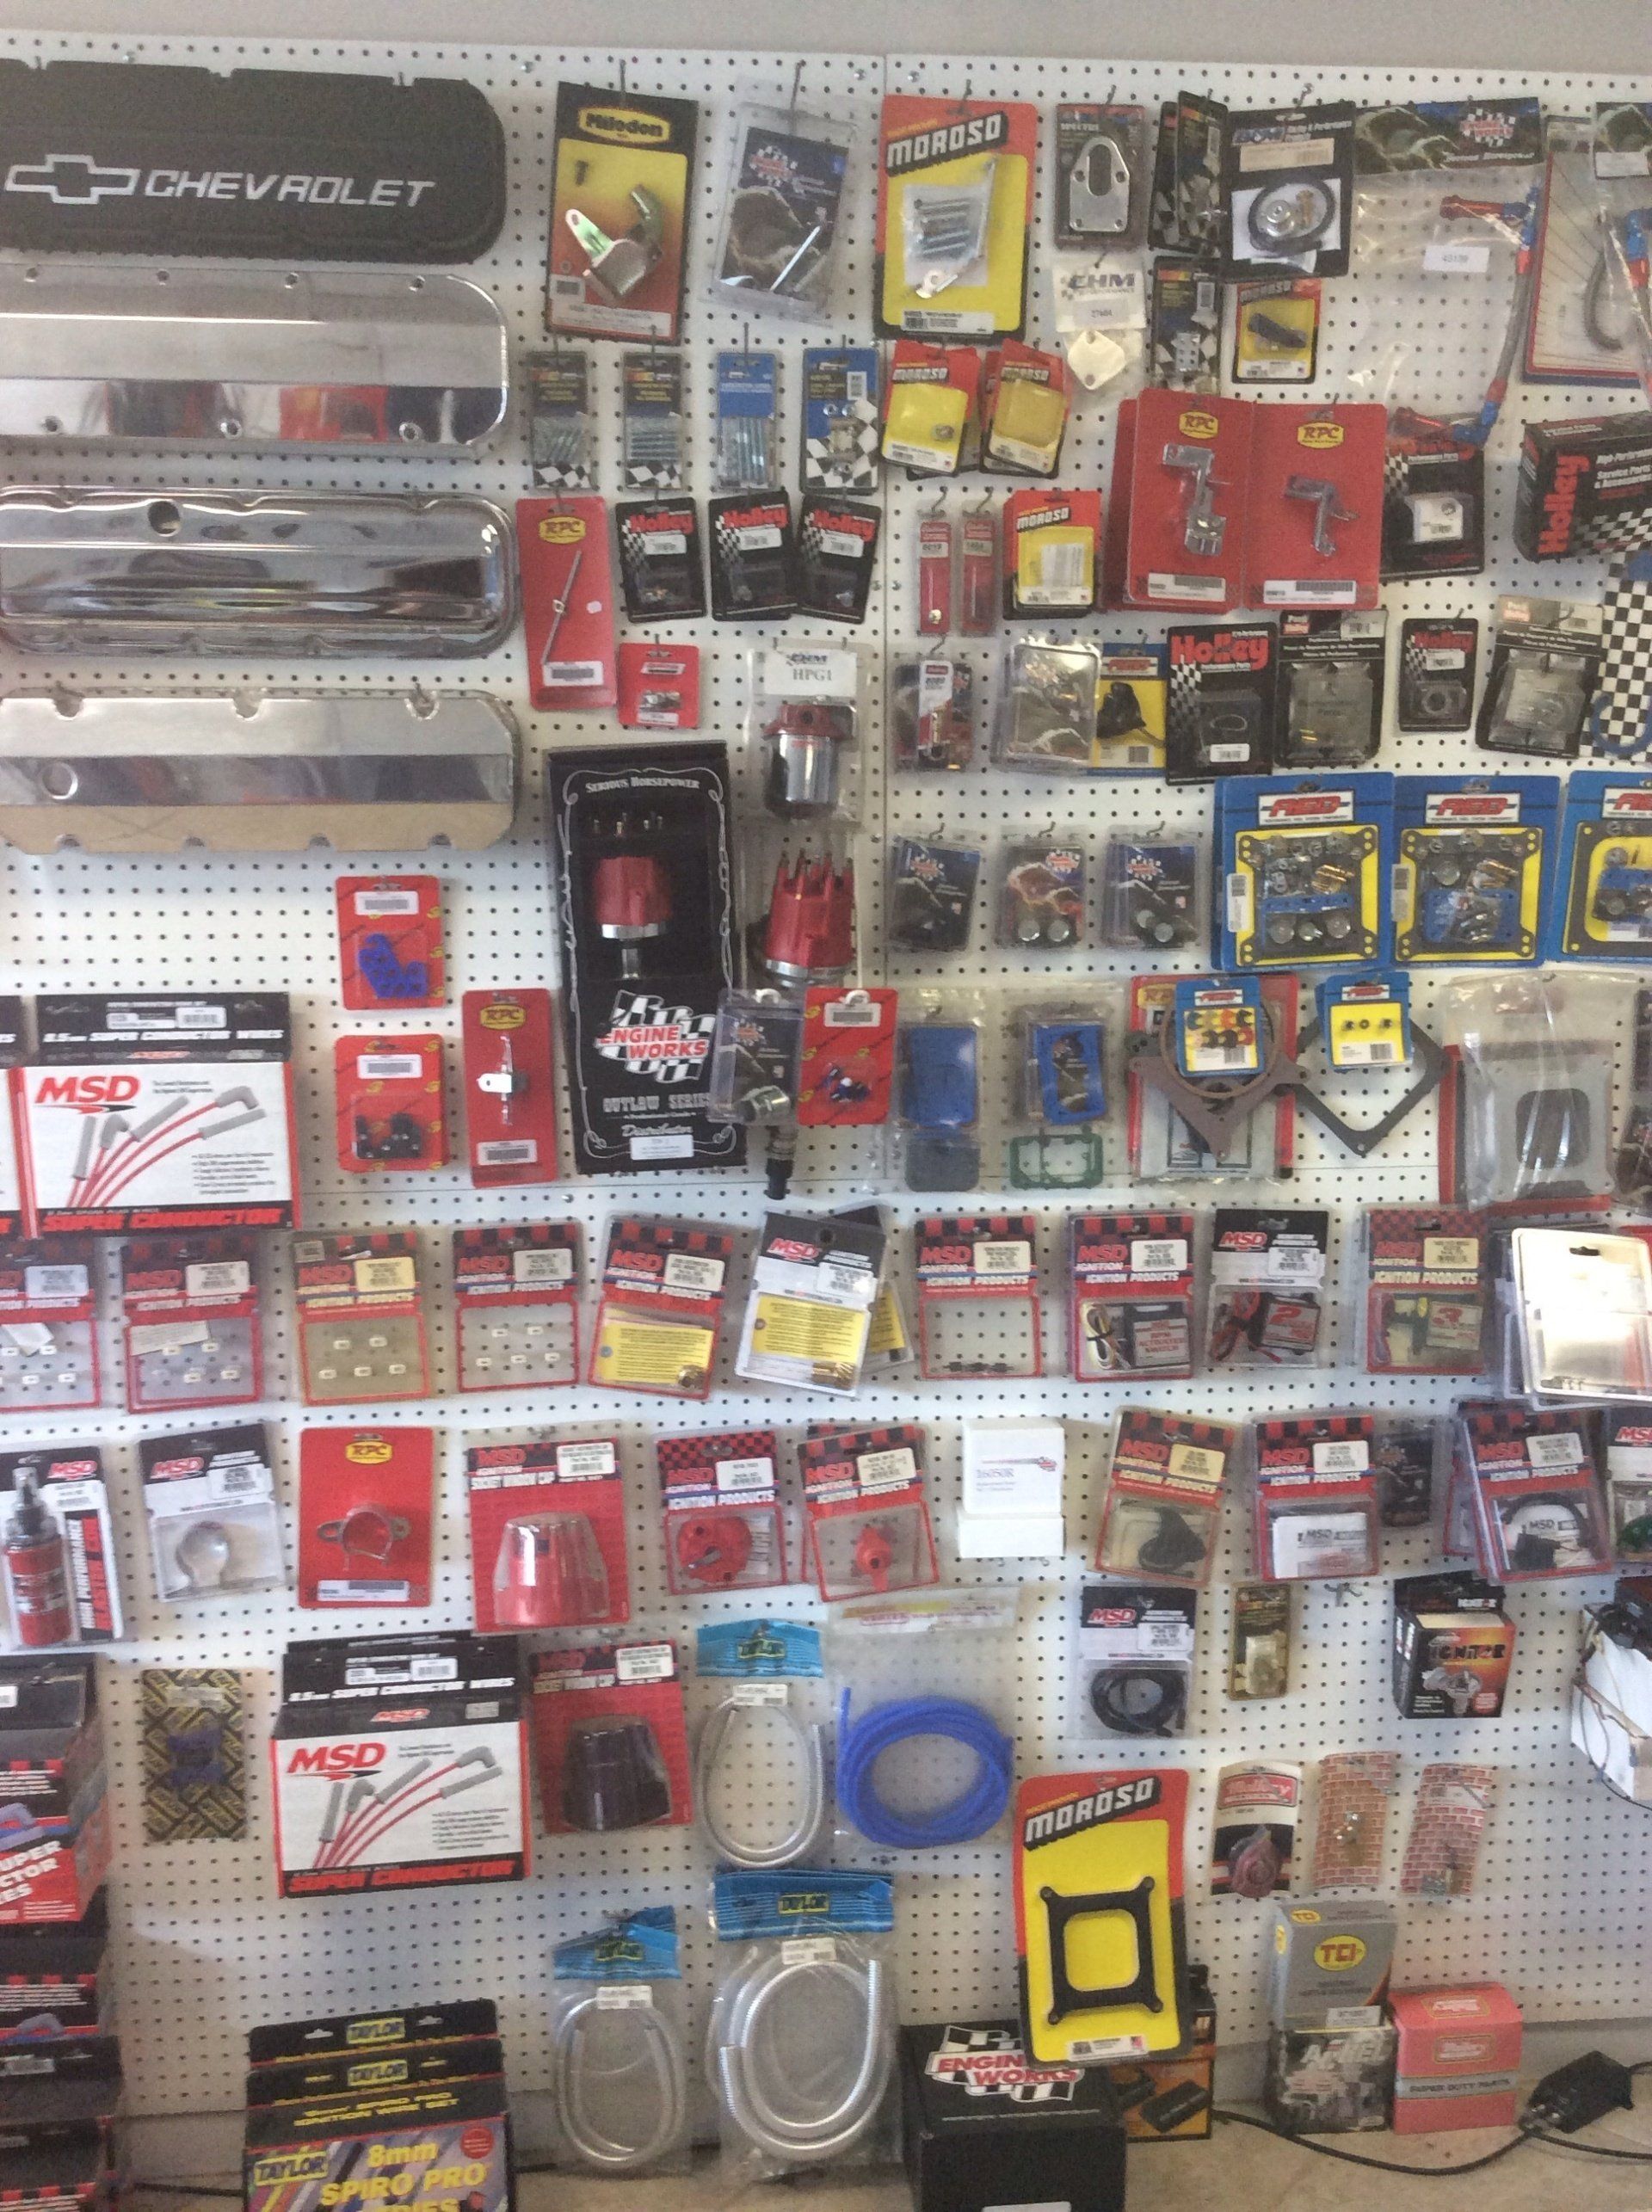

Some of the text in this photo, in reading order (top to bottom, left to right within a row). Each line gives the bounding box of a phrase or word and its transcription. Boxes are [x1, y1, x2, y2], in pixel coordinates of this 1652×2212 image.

[887, 114, 1002, 168] MOROSO
[145, 170, 435, 207] CHEVROLET
[1068, 274, 1135, 289] CHM
[892, 367, 948, 381] MOROSO
[1185, 416, 1214, 429] RPC
[1304, 427, 1341, 439] RPC
[1017, 508, 1069, 530] MOROSO
[1171, 632, 1268, 670] Holley
[792, 669, 832, 681] HPG1
[600, 1026, 679, 1044] ENGINE
[629, 1041, 707, 1058] WORKS
[35, 1075, 140, 1103] MSD
[1220, 1231, 1268, 1246] MSD
[770, 1238, 819, 1260] MSD
[920, 1245, 973, 1263] MSD
[1079, 1244, 1129, 1262] MSD
[611, 1249, 664, 1272] MSD
[1270, 1305, 1302, 1325] 2
[353, 1444, 388, 1457] RPC
[478, 1448, 527, 1466] MSD
[1261, 1447, 1310, 1465] MSD
[1478, 1441, 1525, 1460] MSD
[1089, 1608, 1137, 1623] MSD
[287, 1742, 386, 1773] MSD
[1025, 1778, 1154, 1843] MOROSO
[938, 2055, 1026, 2073] ENGIN
[368, 2142, 440, 2167] 8mm
[321, 2172, 415, 2205] SPIRO
[424, 2162, 487, 2191] PRO
